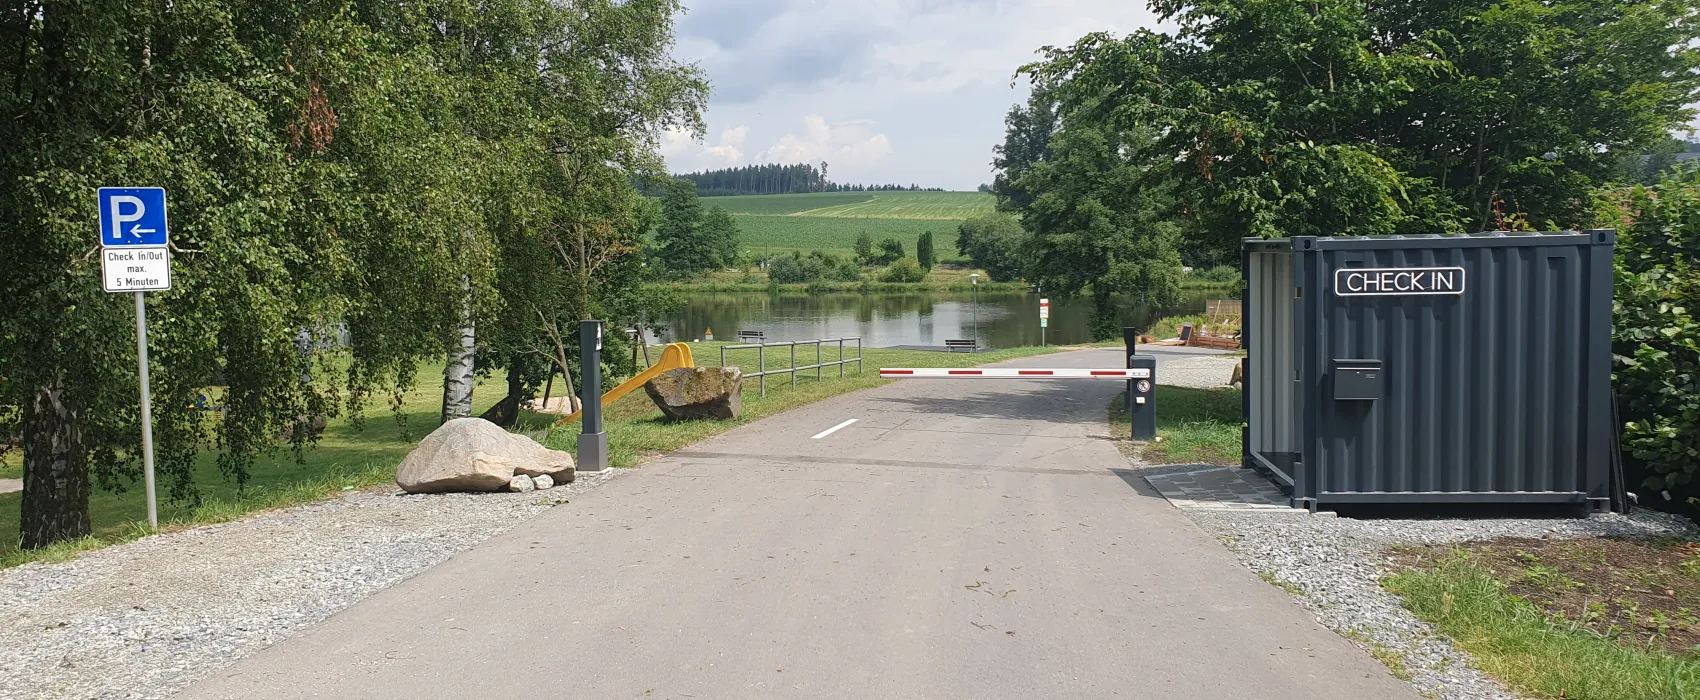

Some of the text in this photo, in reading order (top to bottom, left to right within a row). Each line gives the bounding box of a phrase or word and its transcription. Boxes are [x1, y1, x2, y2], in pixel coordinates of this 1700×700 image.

[110, 195, 146, 239] P
[108, 251, 163, 261] Check In/Out
[116, 277, 159, 287] 5 Minuten
[1347, 271, 1453, 292] CHECK IN
